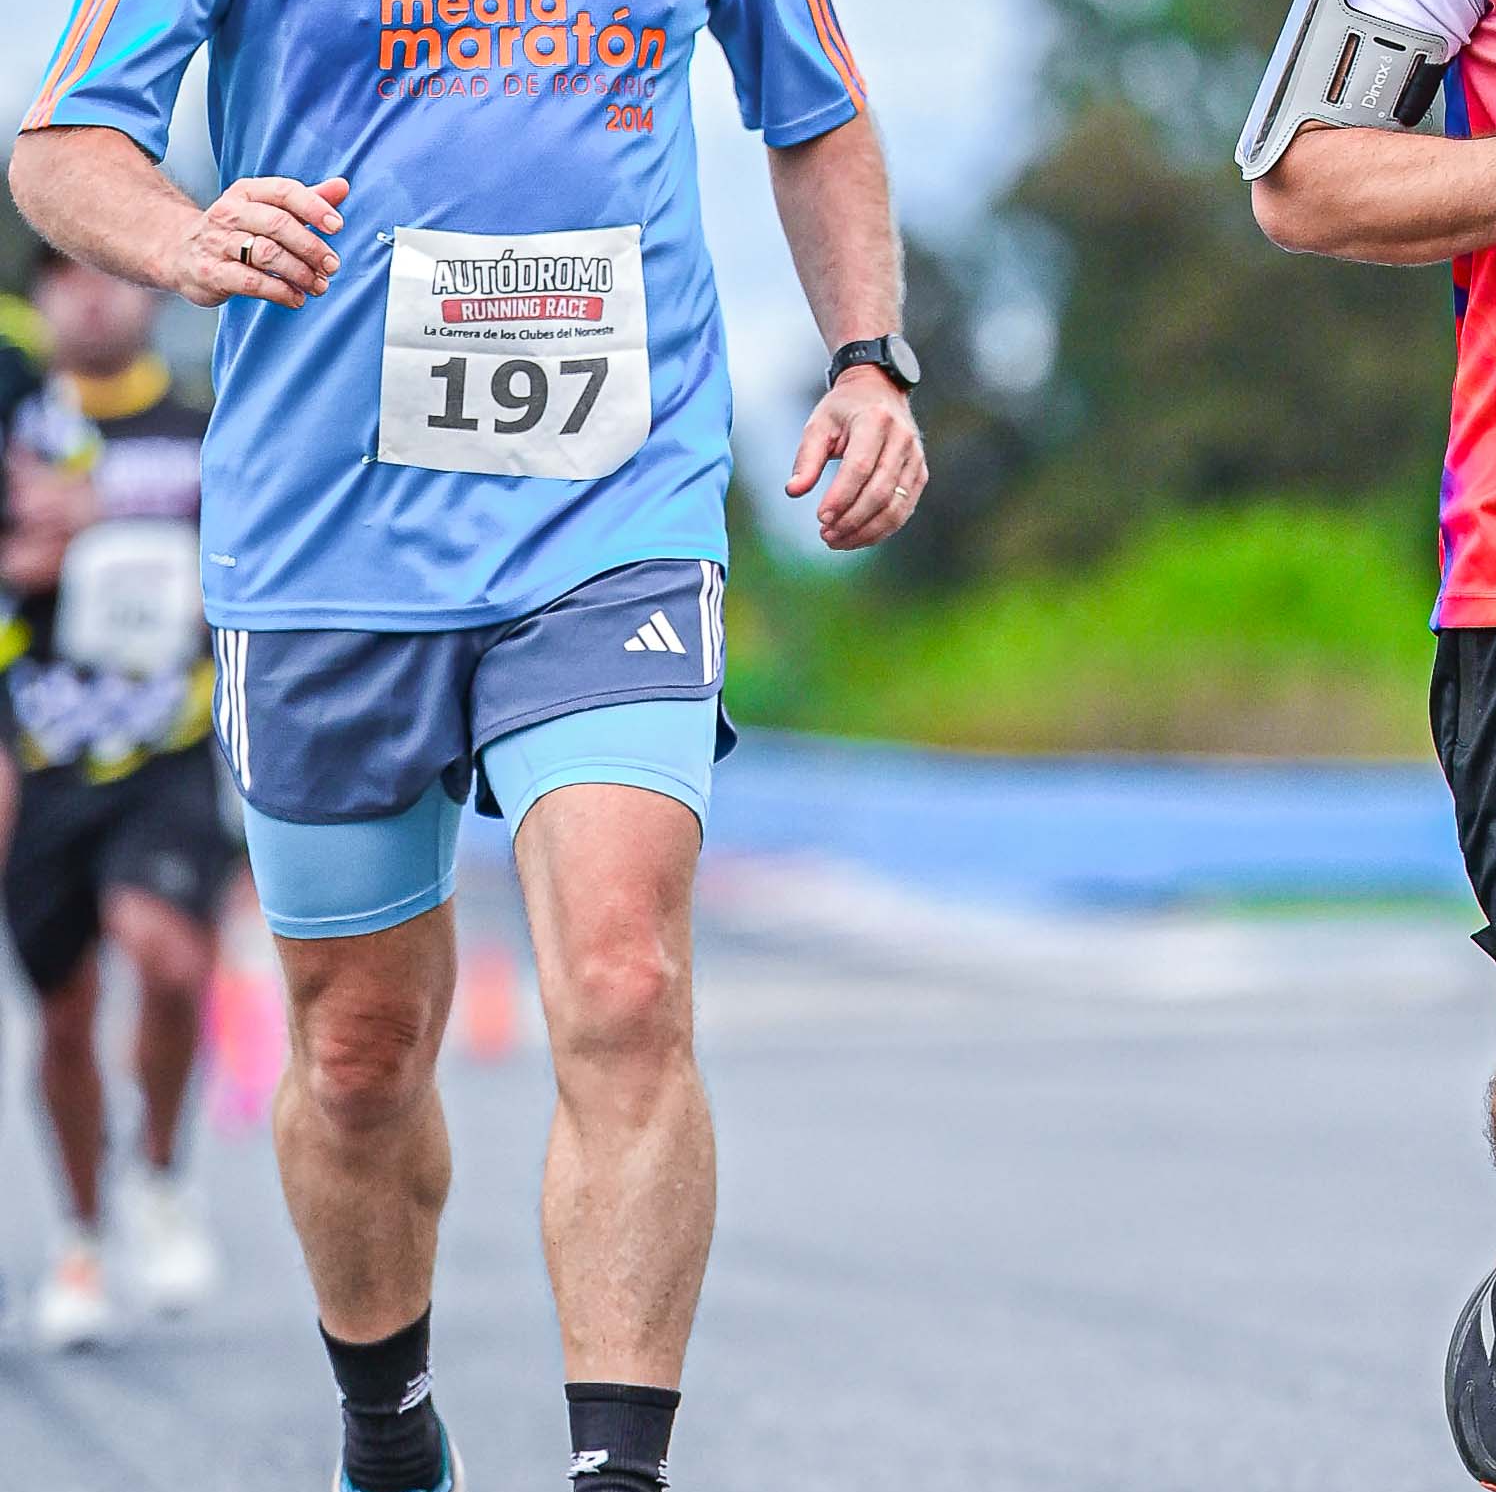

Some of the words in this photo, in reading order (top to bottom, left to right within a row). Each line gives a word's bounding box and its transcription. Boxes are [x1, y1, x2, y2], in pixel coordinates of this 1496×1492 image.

[378, 7, 667, 70] maratón
[377, 75, 489, 100] CIUDAD
[504, 74, 540, 97] DE
[553, 74, 656, 99] ROSARIO
[1361, 63, 1391, 109] Dinax
[606, 104, 654, 133] 2014
[432, 249, 613, 295] AUTÓDROMO
[461, 298, 541, 322] RUNNING
[545, 296, 589, 320] RACE
[424, 325, 437, 336] La
[440, 327, 481, 339] Carrera
[483, 329, 498, 339] de
[500, 329, 517, 340] los
[519, 329, 554, 341] Clubes
[556, 328, 573, 339] del
[574, 326, 615, 338] Noroeste
[427, 357, 609, 435] 197
